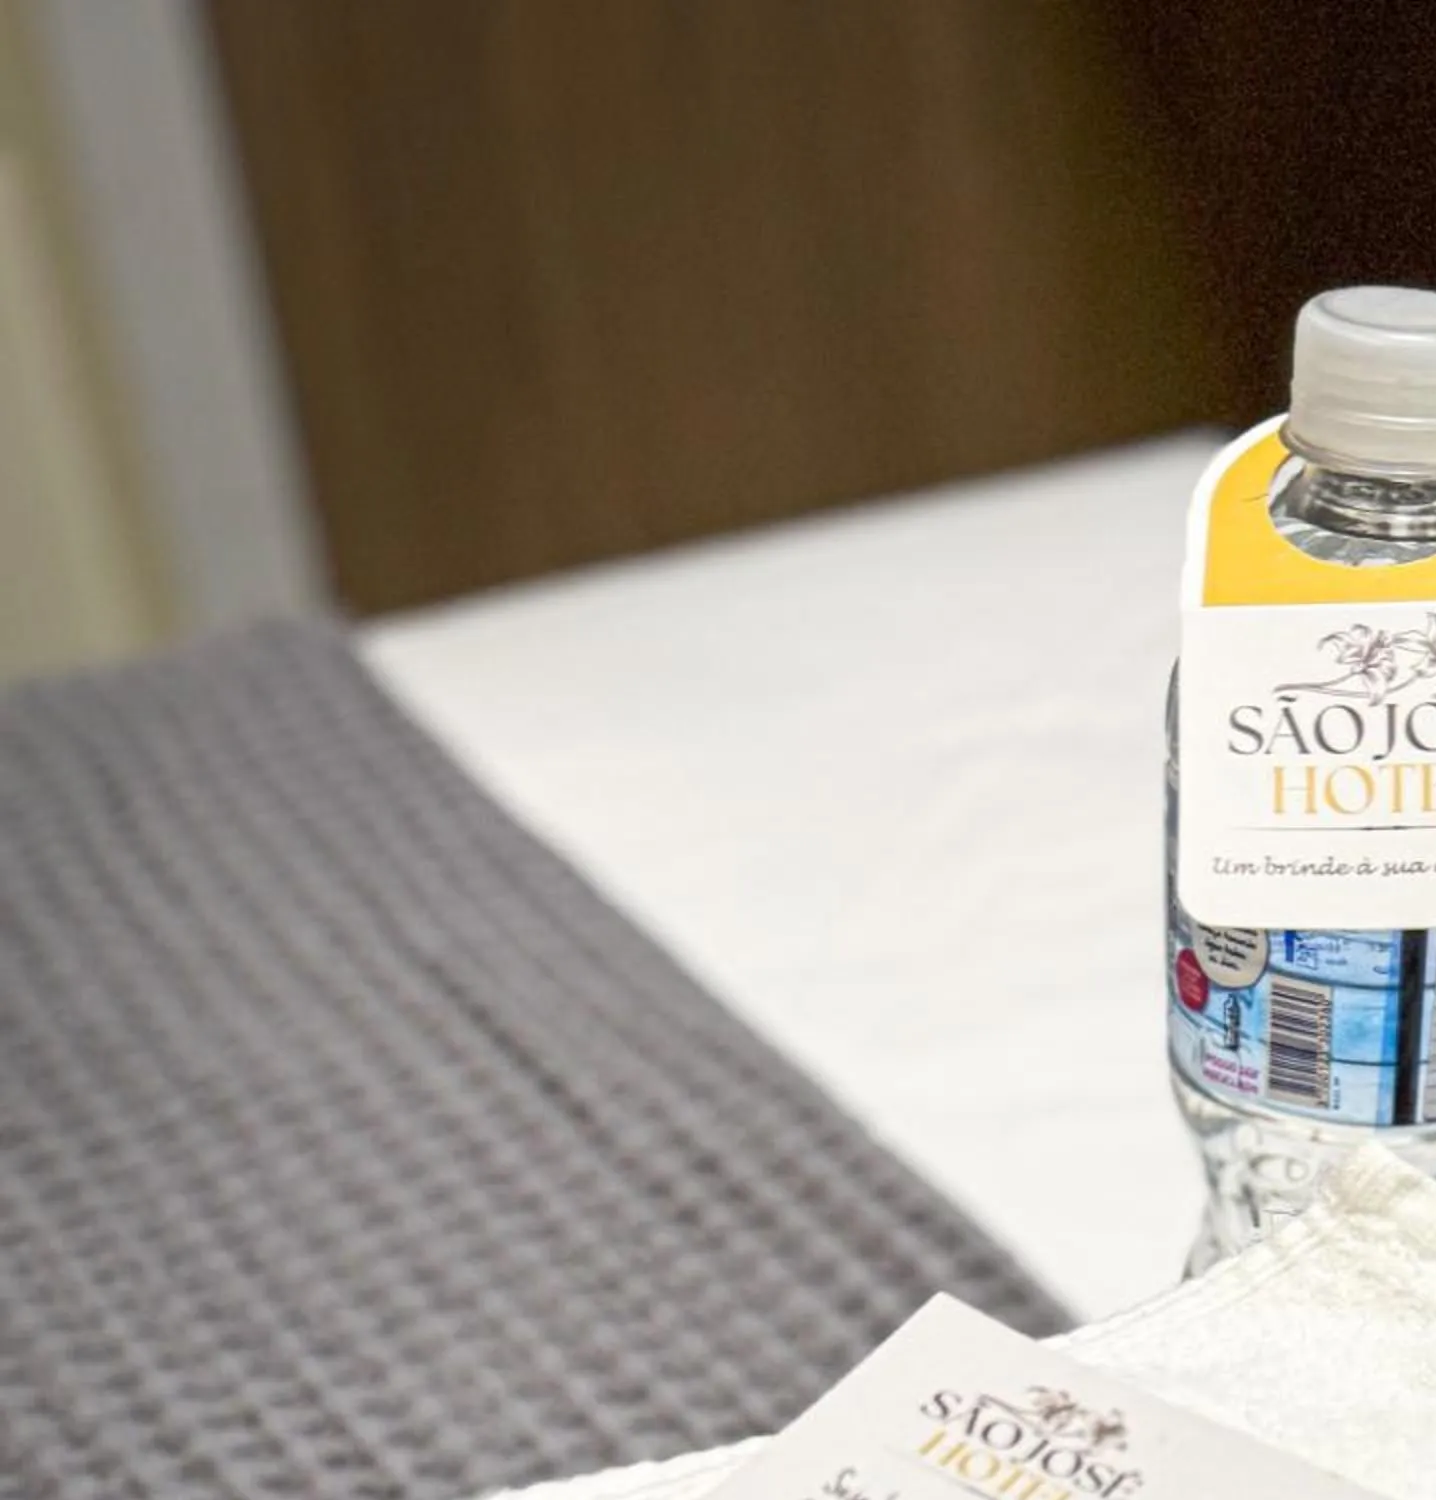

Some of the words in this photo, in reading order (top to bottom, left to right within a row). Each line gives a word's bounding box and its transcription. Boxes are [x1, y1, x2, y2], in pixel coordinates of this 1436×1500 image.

[1228, 695, 1364, 755] SÃO
[1212, 857, 1261, 877] Um
[1265, 855, 1351, 877] brinde
[1354, 855, 1376, 876] à
[1381, 857, 1428, 877] sua
